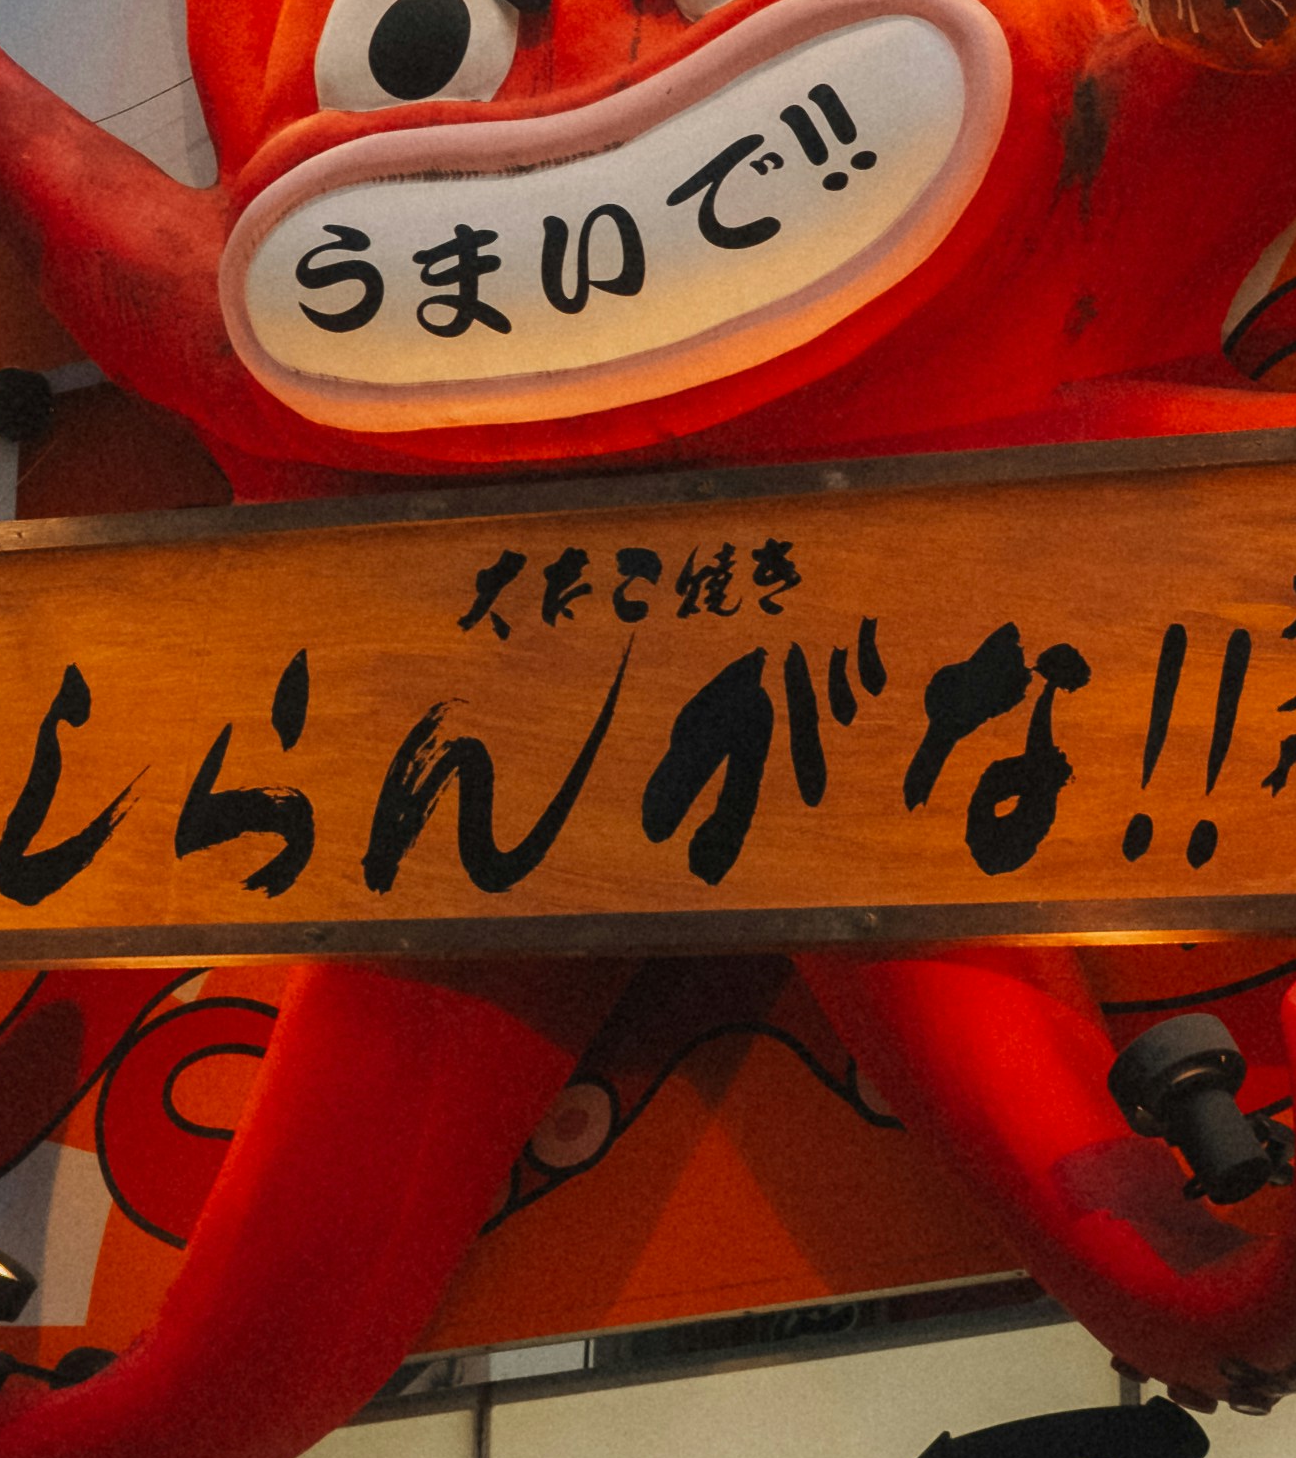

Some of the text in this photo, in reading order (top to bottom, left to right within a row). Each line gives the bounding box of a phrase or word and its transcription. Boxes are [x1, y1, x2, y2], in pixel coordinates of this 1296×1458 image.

[295, 83, 878, 338] うまいで!!
[456, 539, 803, 639] 大たこ焼き
